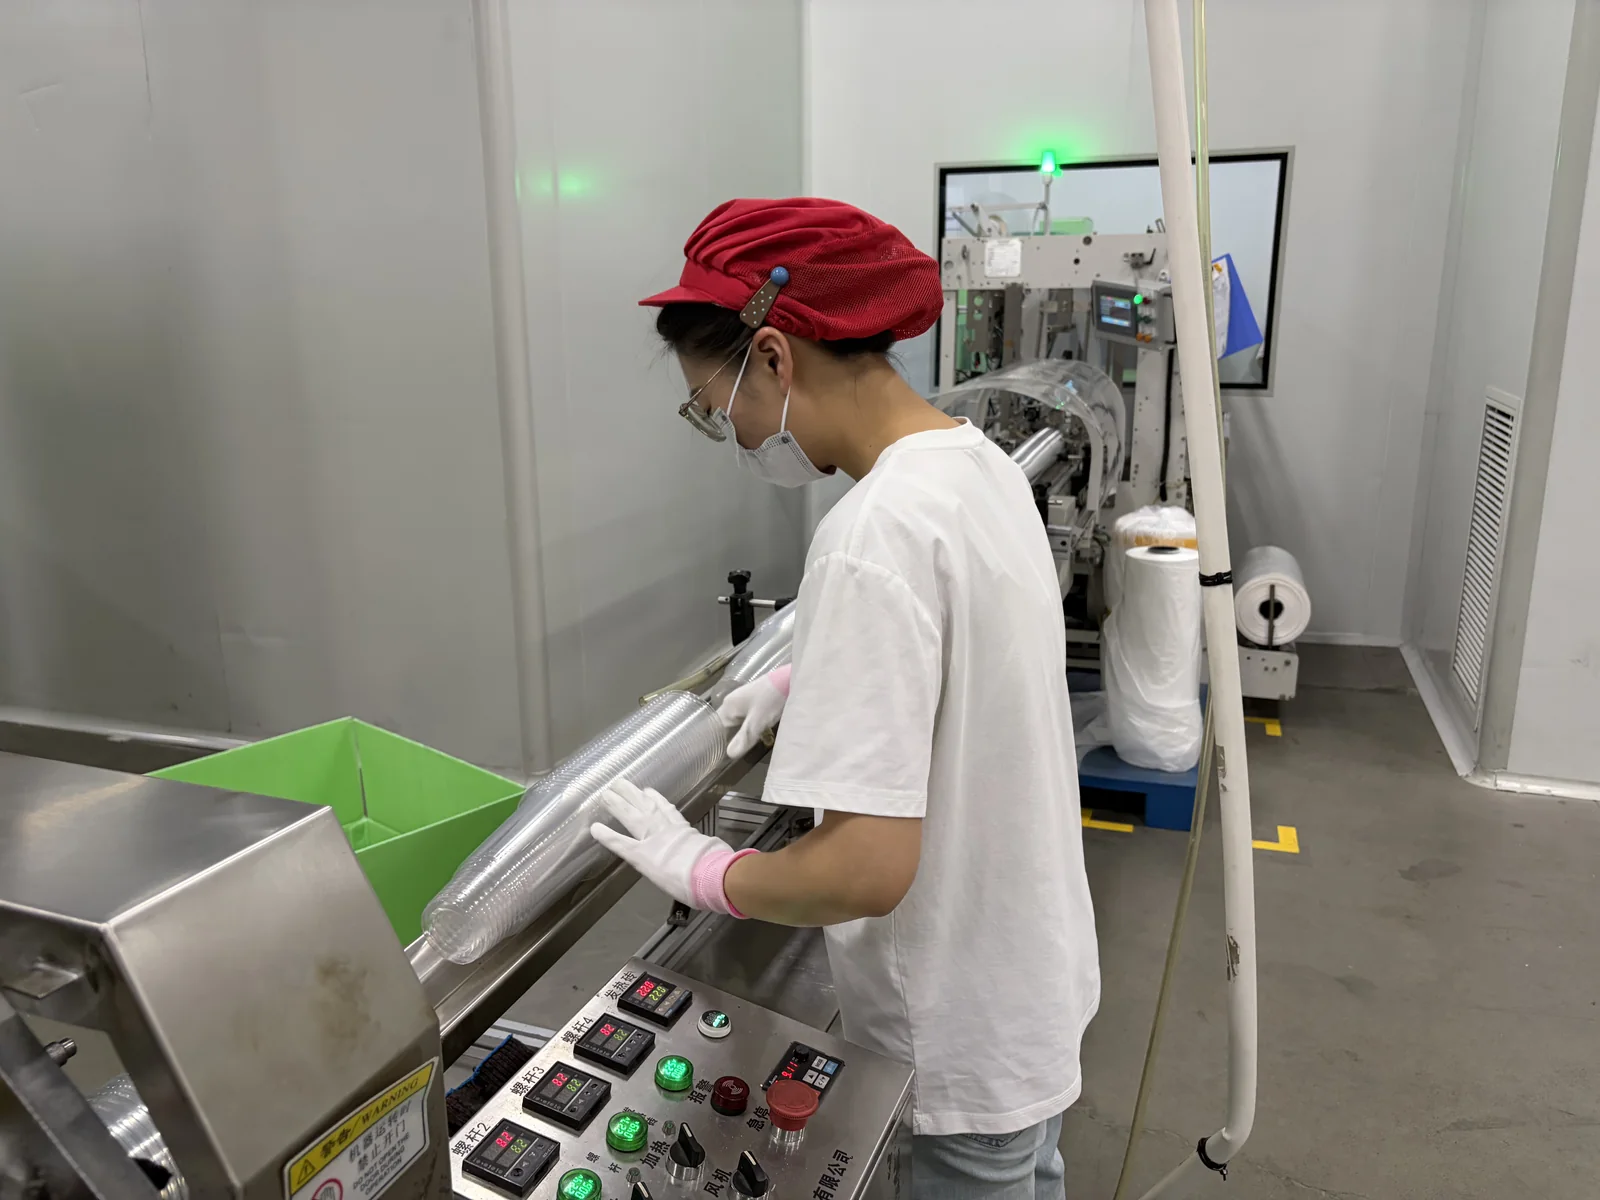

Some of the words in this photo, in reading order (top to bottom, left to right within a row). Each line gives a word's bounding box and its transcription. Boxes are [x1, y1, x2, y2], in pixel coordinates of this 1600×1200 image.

[604, 971, 637, 1000] 发热砖
[560, 1017, 594, 1044] 螺杆4
[599, 1023, 616, 1036] 82
[613, 1028, 628, 1041] 82
[509, 1066, 545, 1096] 螺杆3
[551, 1072, 568, 1087] 82
[566, 1078, 581, 1092] 82
[688, 1079, 714, 1104] 报警
[349, 1099, 413, 1163] 机器运转时
[746, 1105, 771, 1132] 急停
[357, 1119, 406, 1173] 禁止开门
[450, 1122, 491, 1157] 螺杆2
[495, 1131, 514, 1148] 82
[510, 1138, 528, 1154] 82
[352, 1175, 364, 1190] DO
[363, 1163, 378, 1179] NOT
[378, 1145, 397, 1166] OPEN
[395, 1131, 411, 1148] THE
[359, 1168, 381, 1193] DOOR
[379, 1145, 406, 1173] DURING
[640, 1140, 671, 1169] 加热
[365, 1158, 402, 1196] OPERATION
[703, 1168, 733, 1198] 风机
[812, 1149, 853, 1200] 有限公司
